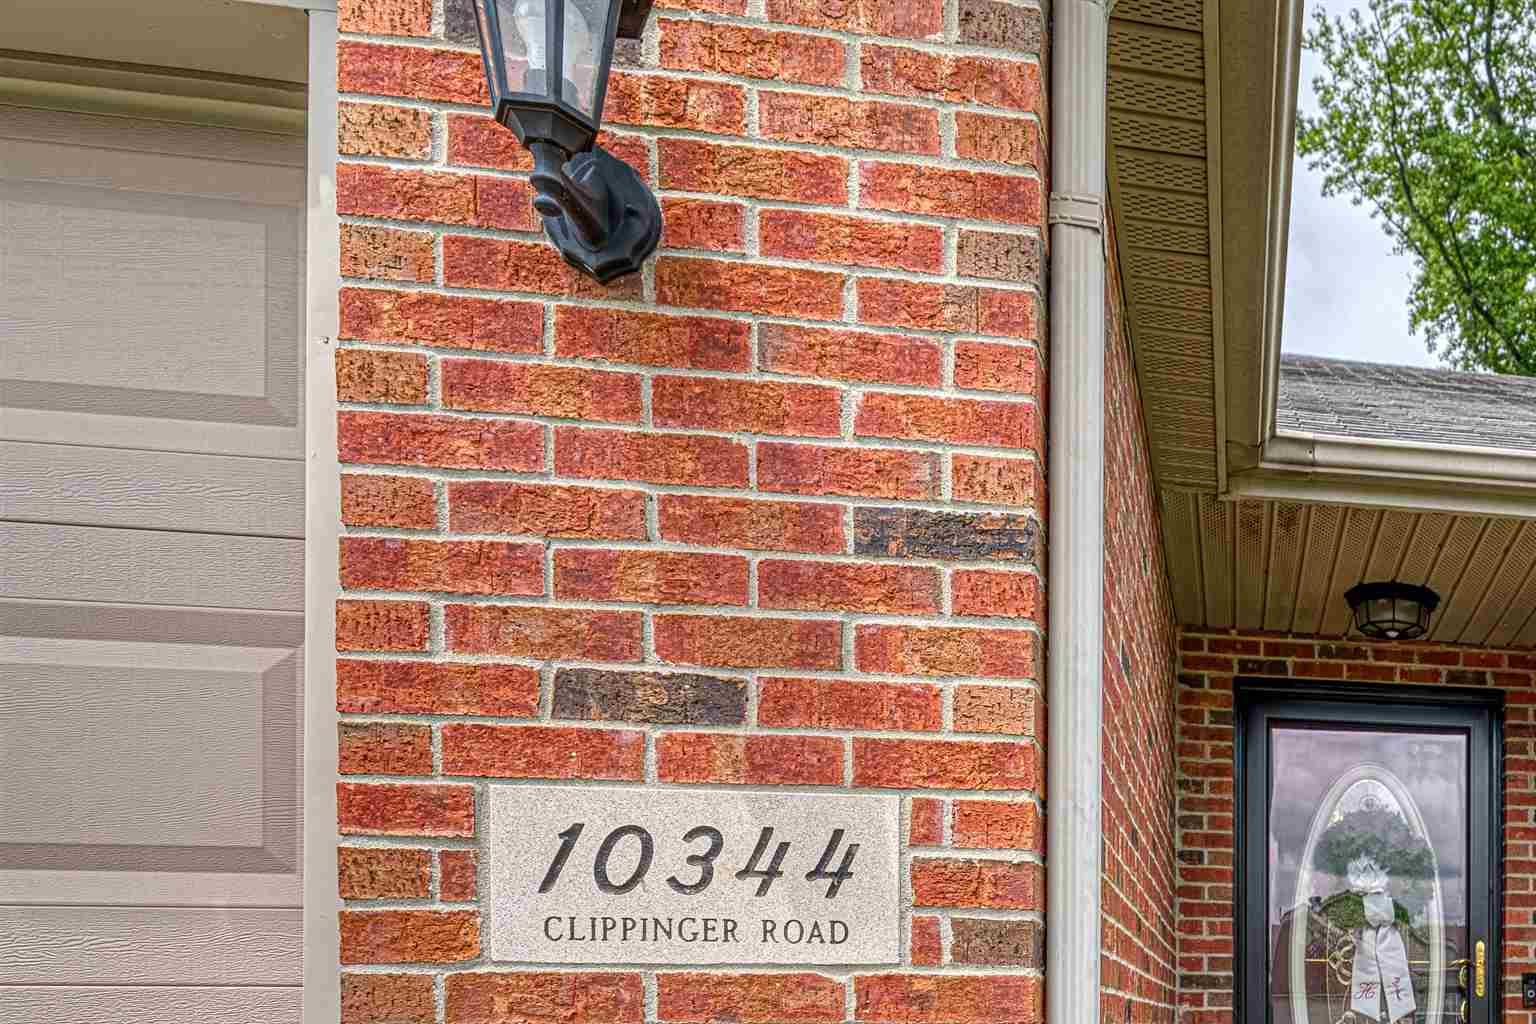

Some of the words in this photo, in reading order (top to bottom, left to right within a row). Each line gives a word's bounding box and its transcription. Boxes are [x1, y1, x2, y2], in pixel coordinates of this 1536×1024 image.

[538, 822, 860, 899] 10344
[543, 916, 739, 943] CLIPPINGER
[761, 918, 850, 944] ROAD
